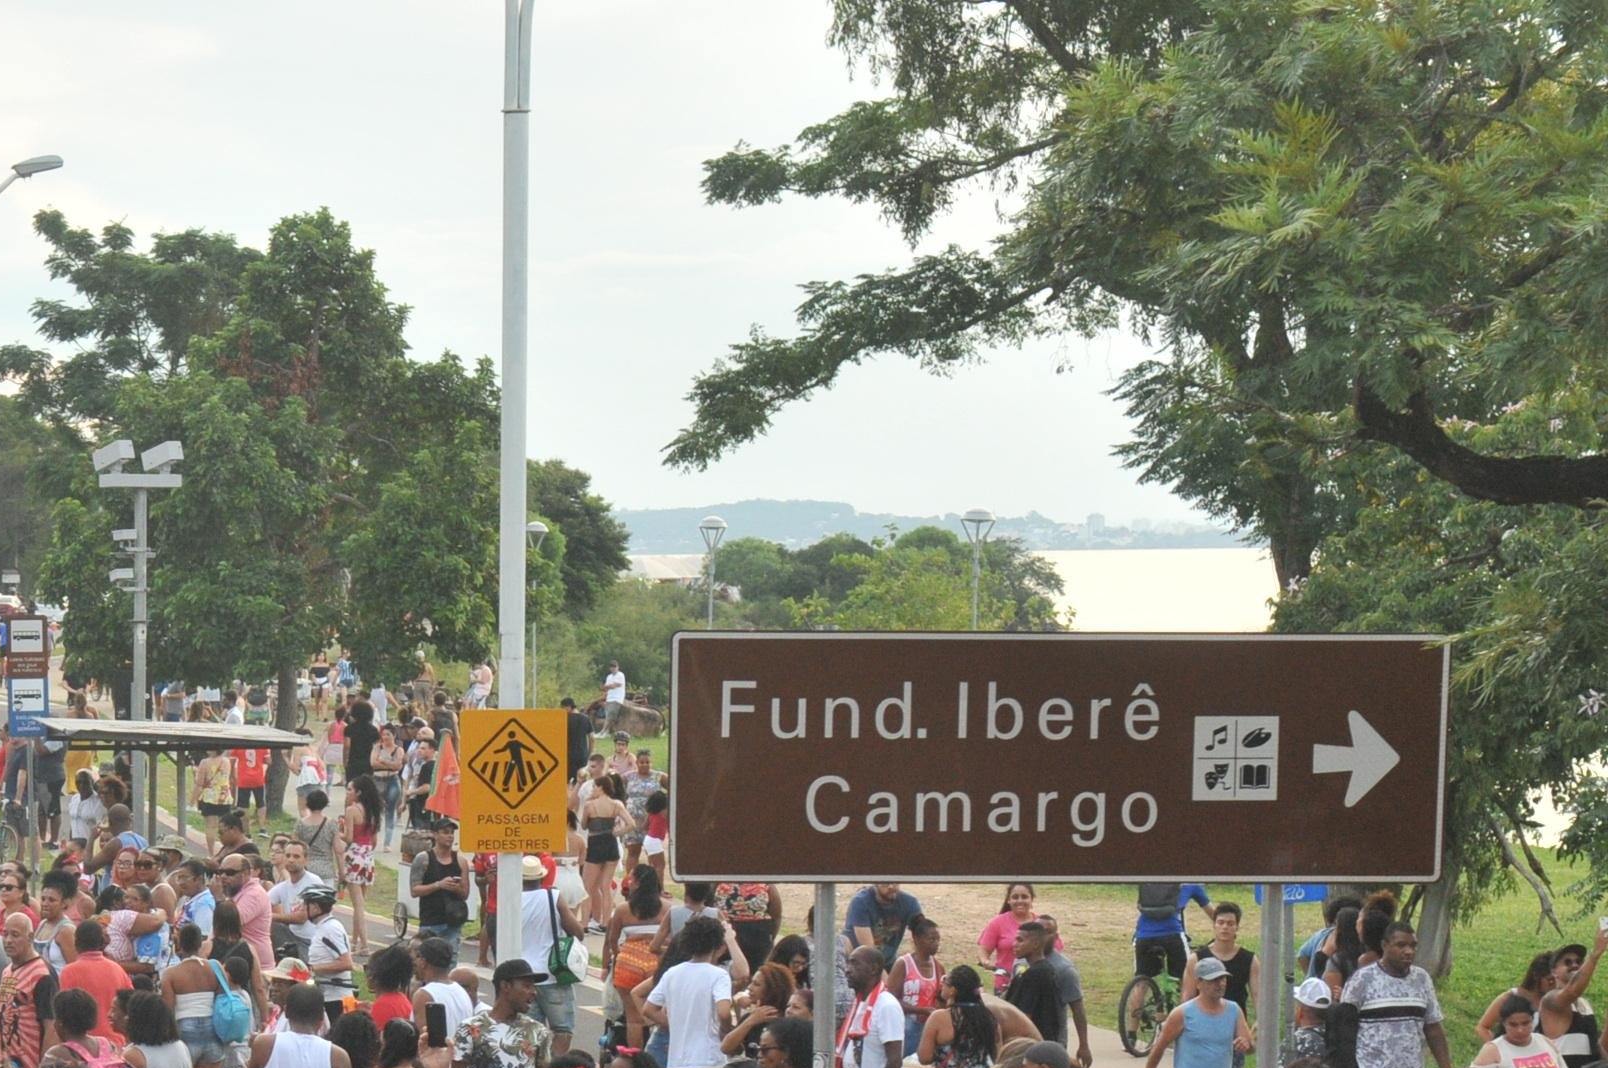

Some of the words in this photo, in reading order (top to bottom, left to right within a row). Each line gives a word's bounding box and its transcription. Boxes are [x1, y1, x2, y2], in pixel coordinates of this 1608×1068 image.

[720, 681, 928, 740] Fund.
[958, 681, 1161, 741] Iberê
[805, 775, 1158, 847] Camargo
[477, 813, 550, 825] PASSAGEM
[504, 828, 521, 837] DE
[477, 839, 550, 850] PEDESTRES
